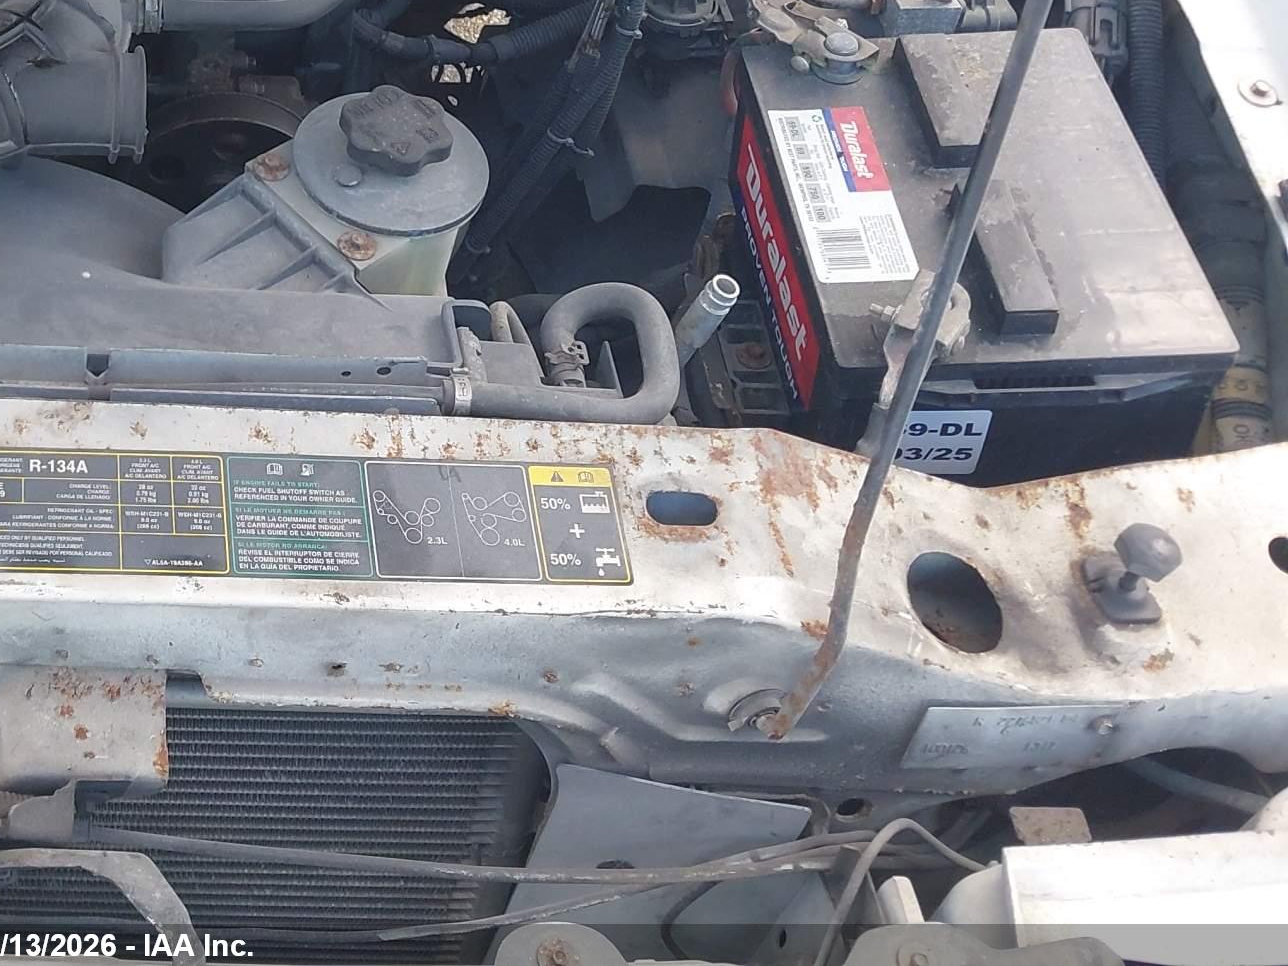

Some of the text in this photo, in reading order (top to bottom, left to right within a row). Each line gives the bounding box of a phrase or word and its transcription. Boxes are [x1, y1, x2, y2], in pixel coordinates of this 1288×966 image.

[840, 120, 875, 179] Duralast
[815, 207, 827, 222] 100
[747, 143, 809, 362] Duralast
[742, 206, 799, 401] PROVEN TOUGH
[904, 422, 983, 437] 9-DL
[29, 459, 88, 473] R-134A
[233, 486, 256, 494] CHECK
[276, 487, 306, 495] SHUTOFF
[234, 493, 281, 501] REFERENCED
[335, 495, 357, 503] GUIDE.
[539, 497, 571, 509] 50%
[267, 515, 361, 524] LA COMMANDE DE COUPURE
[247, 521, 289, 529] CARBURANT,
[291, 522, 316, 530] COMME
[257, 528, 266, 536] LE
[426, 536, 447, 545] 2.3L
[503, 538, 524, 546] 4.0L
[253, 556, 302, 564] COMBUSTIBLE
[549, 553, 581, 566] 50%
[250, 562, 258, 570] LA
